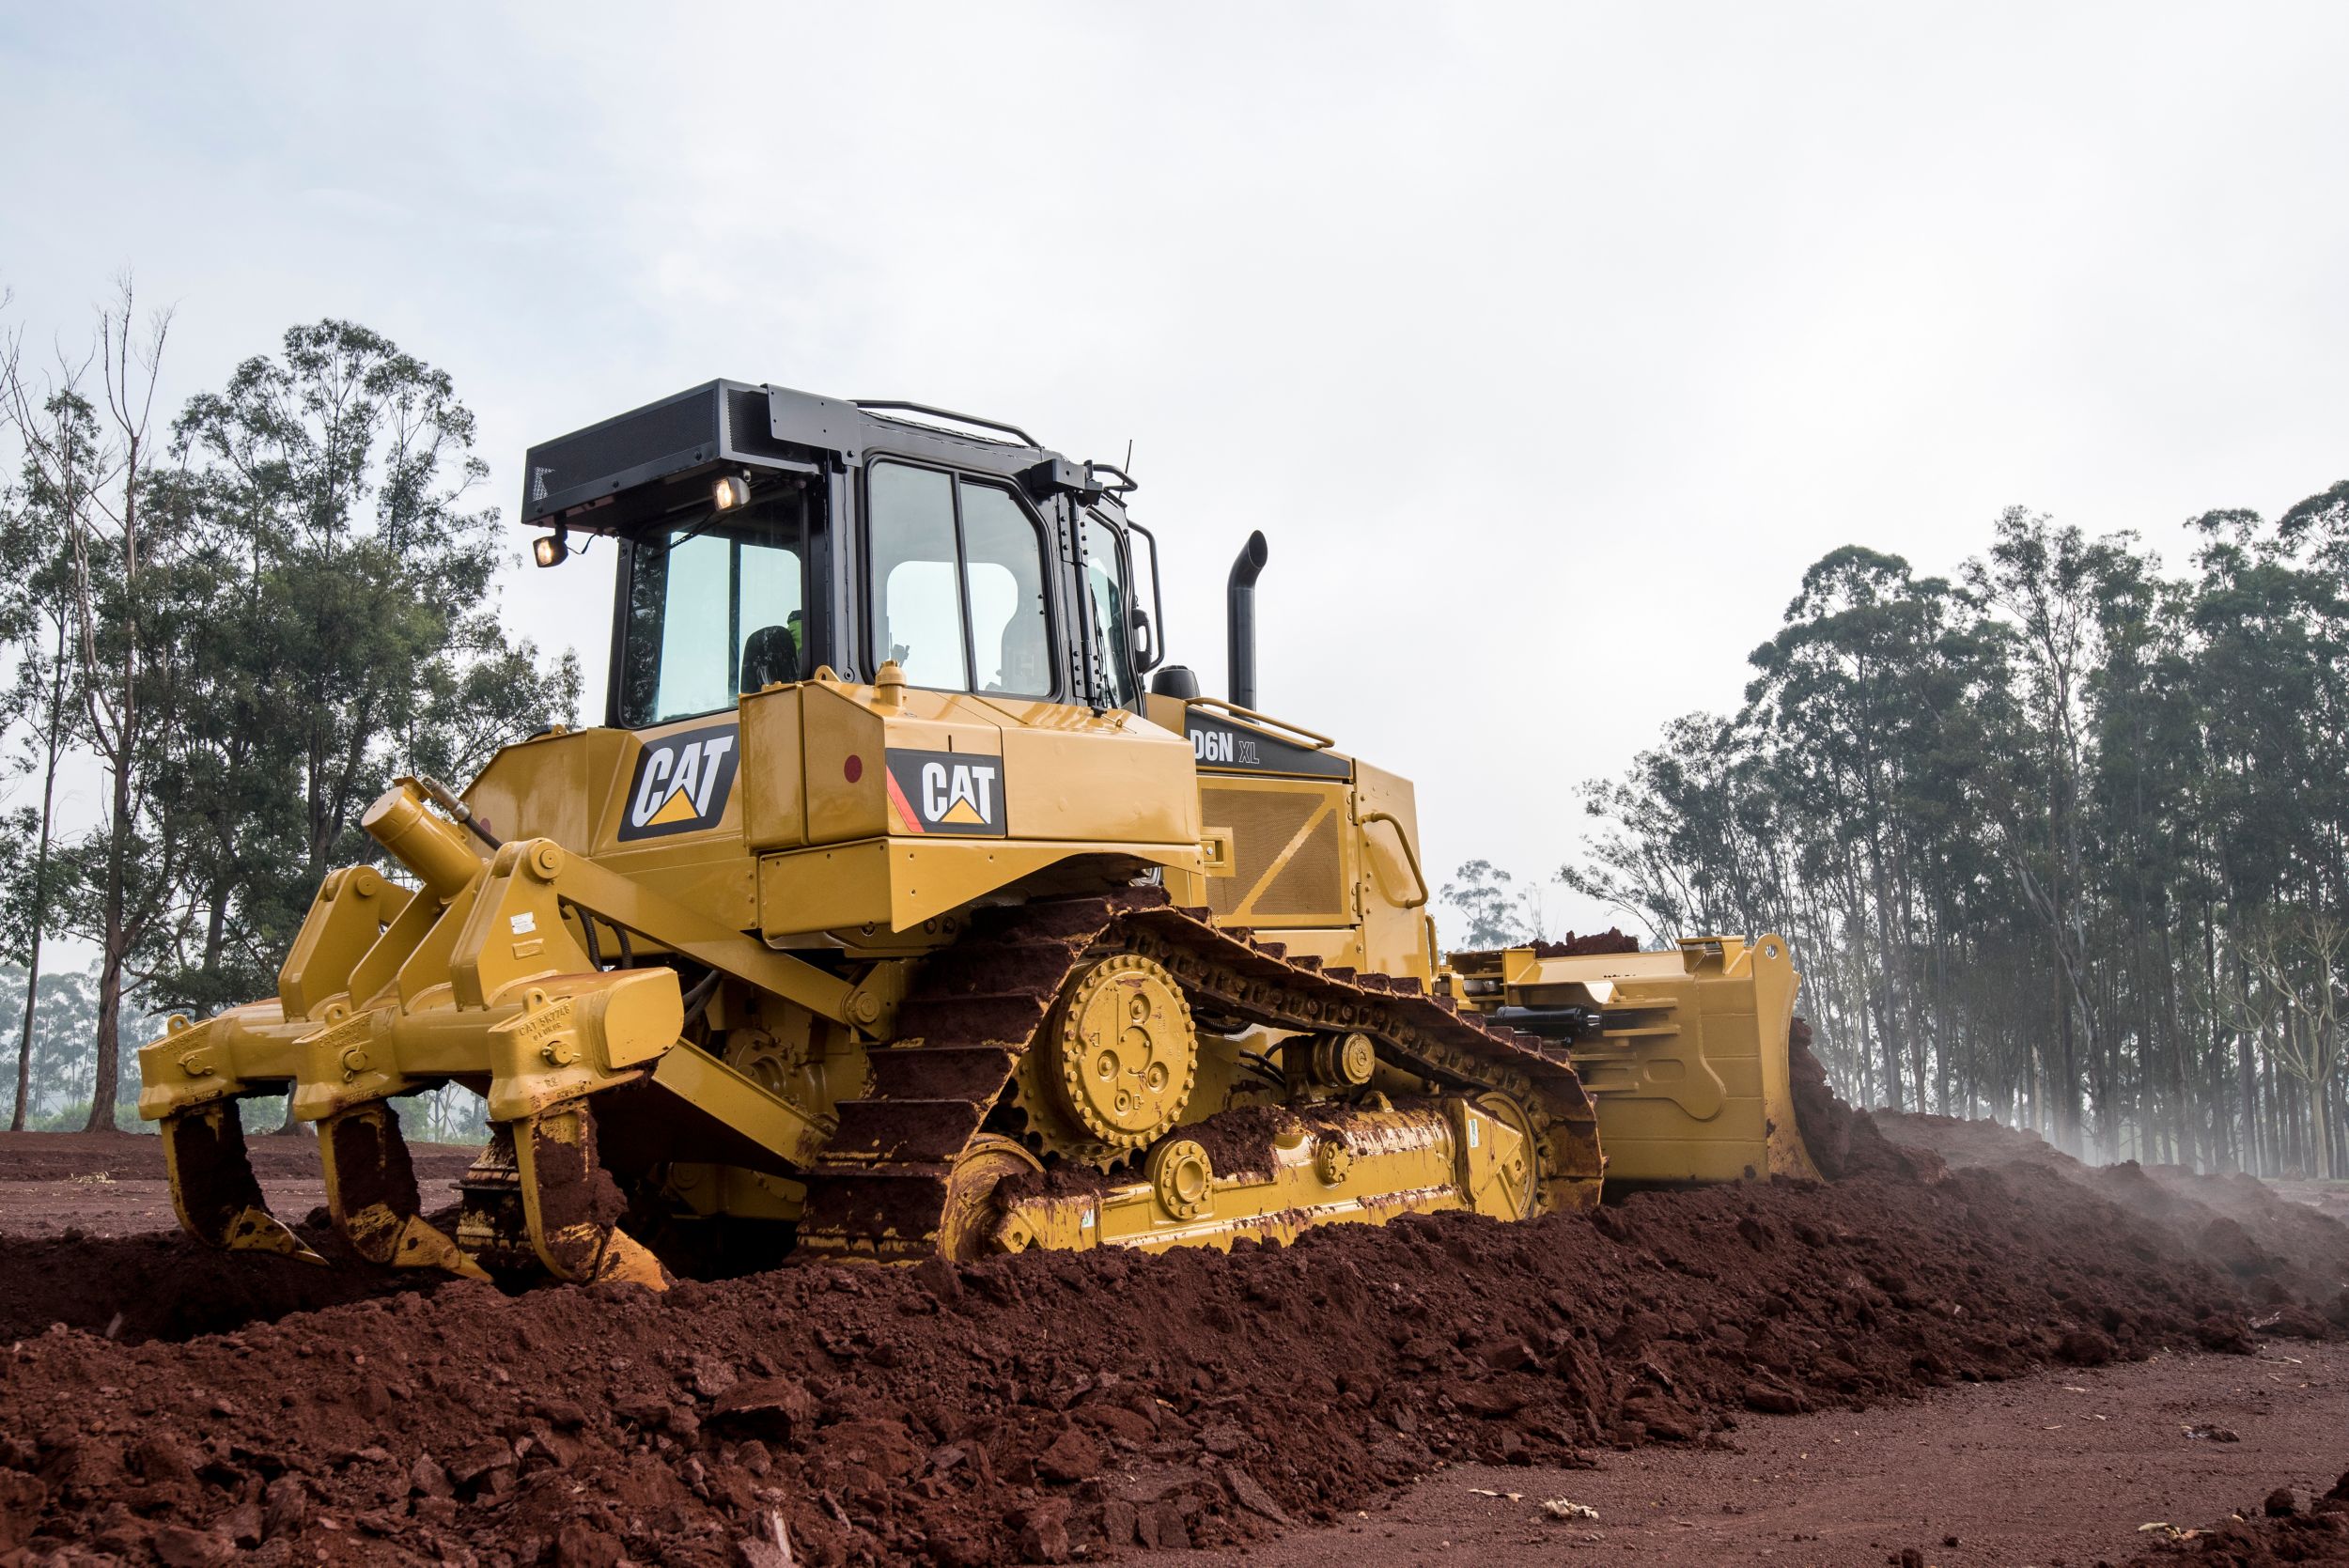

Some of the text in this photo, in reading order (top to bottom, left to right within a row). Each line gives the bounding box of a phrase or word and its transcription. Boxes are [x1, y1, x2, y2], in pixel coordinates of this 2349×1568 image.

[1190, 729, 1259, 764] D6N XL
[631, 736, 735, 828] CAT
[922, 762, 995, 824] CAT
[319, 1032, 334, 1048] CAT
[519, 1021, 537, 1036] CAT
